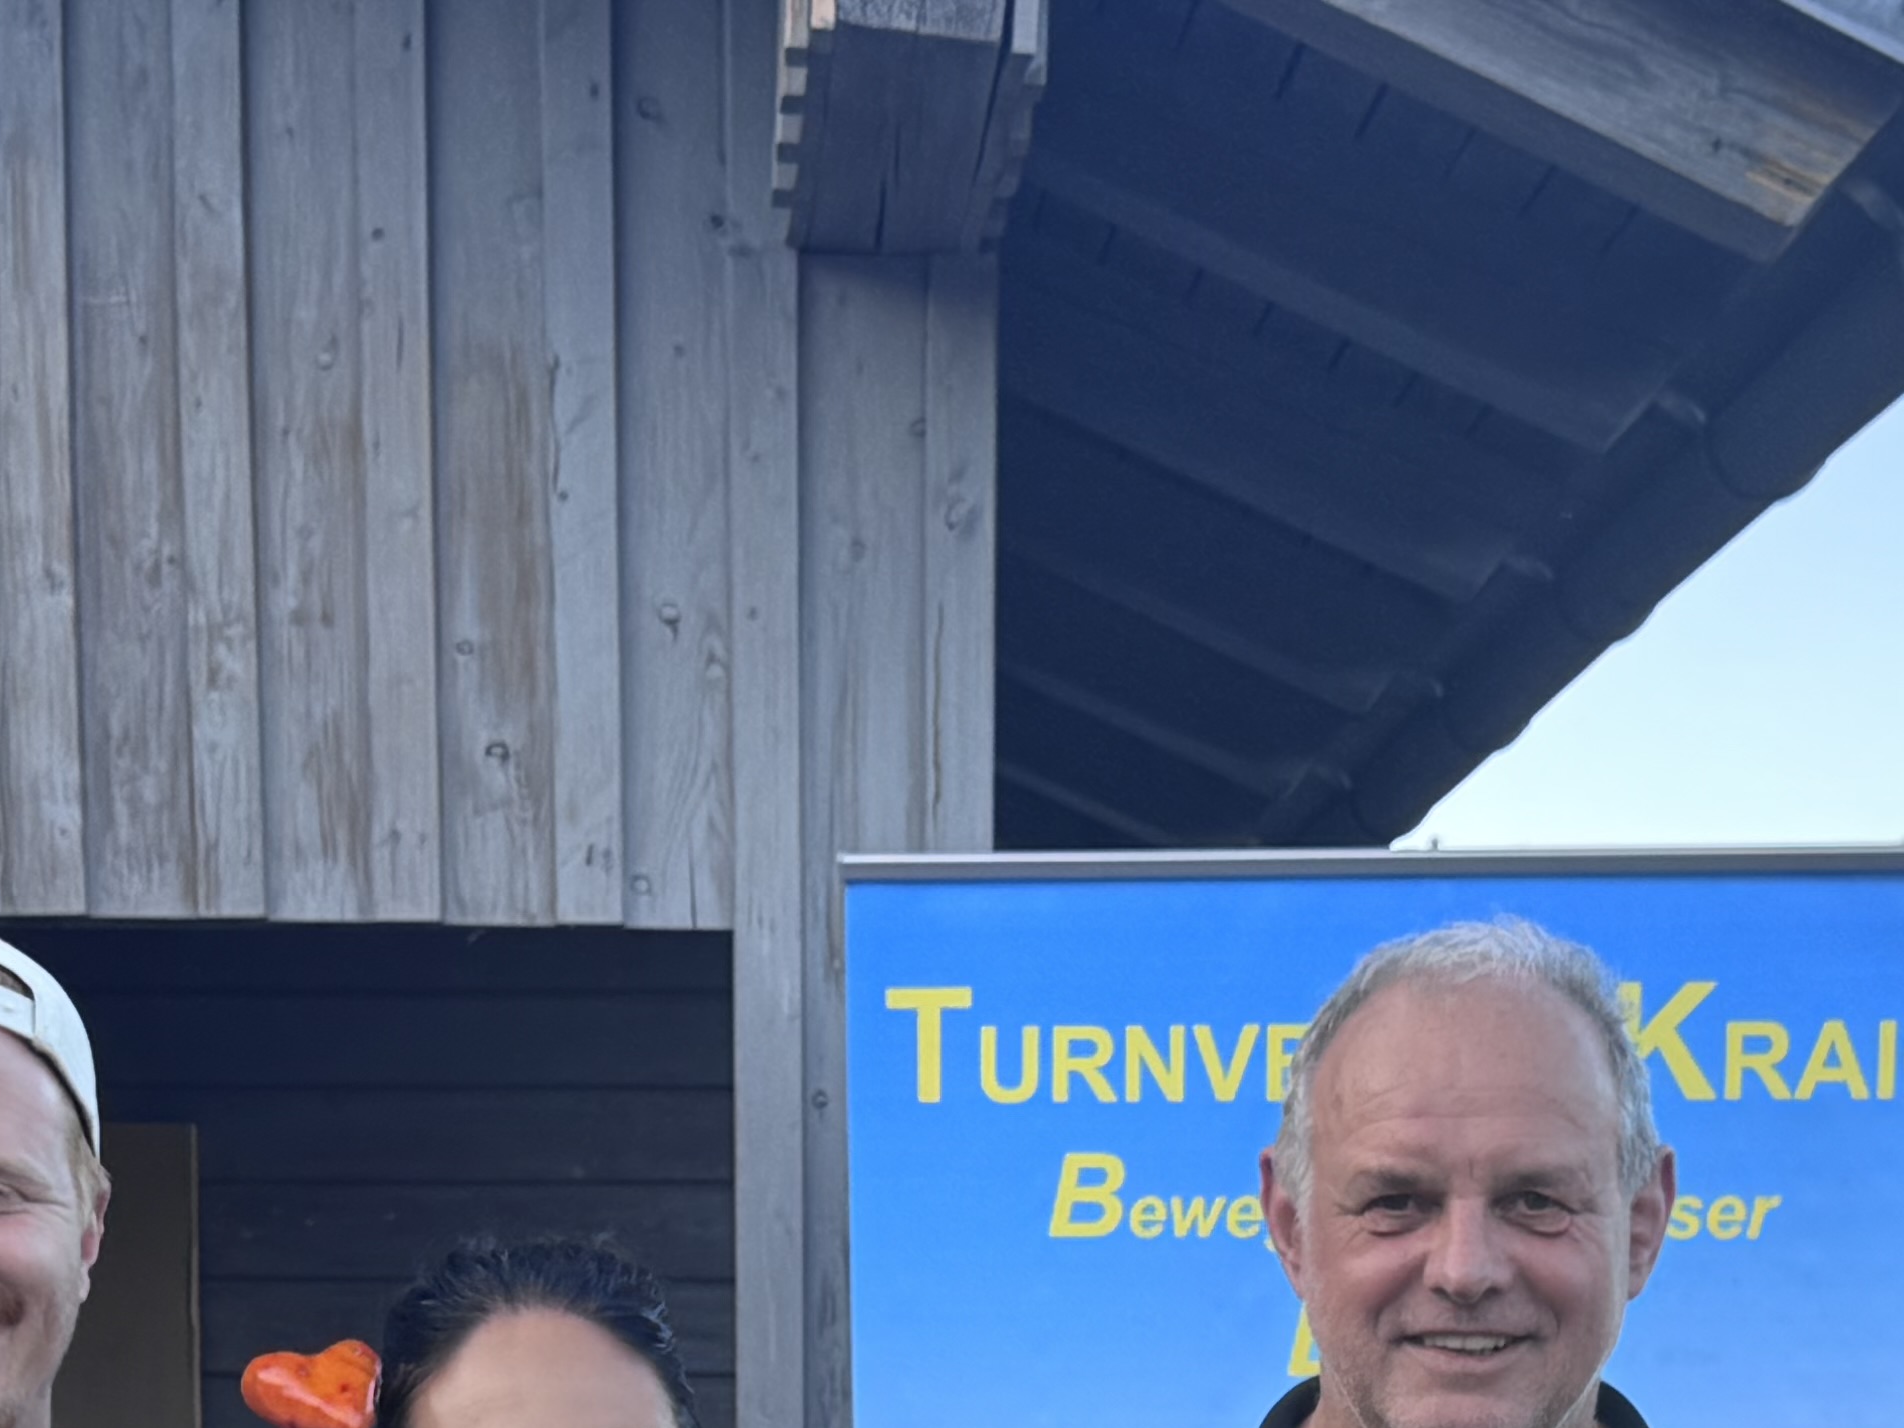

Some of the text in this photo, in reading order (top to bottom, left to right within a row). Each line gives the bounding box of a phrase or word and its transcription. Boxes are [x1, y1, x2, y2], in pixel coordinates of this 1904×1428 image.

[885, 986, 1309, 1104] TURNVE
[1048, 1152, 1783, 1241] Bewe ser
